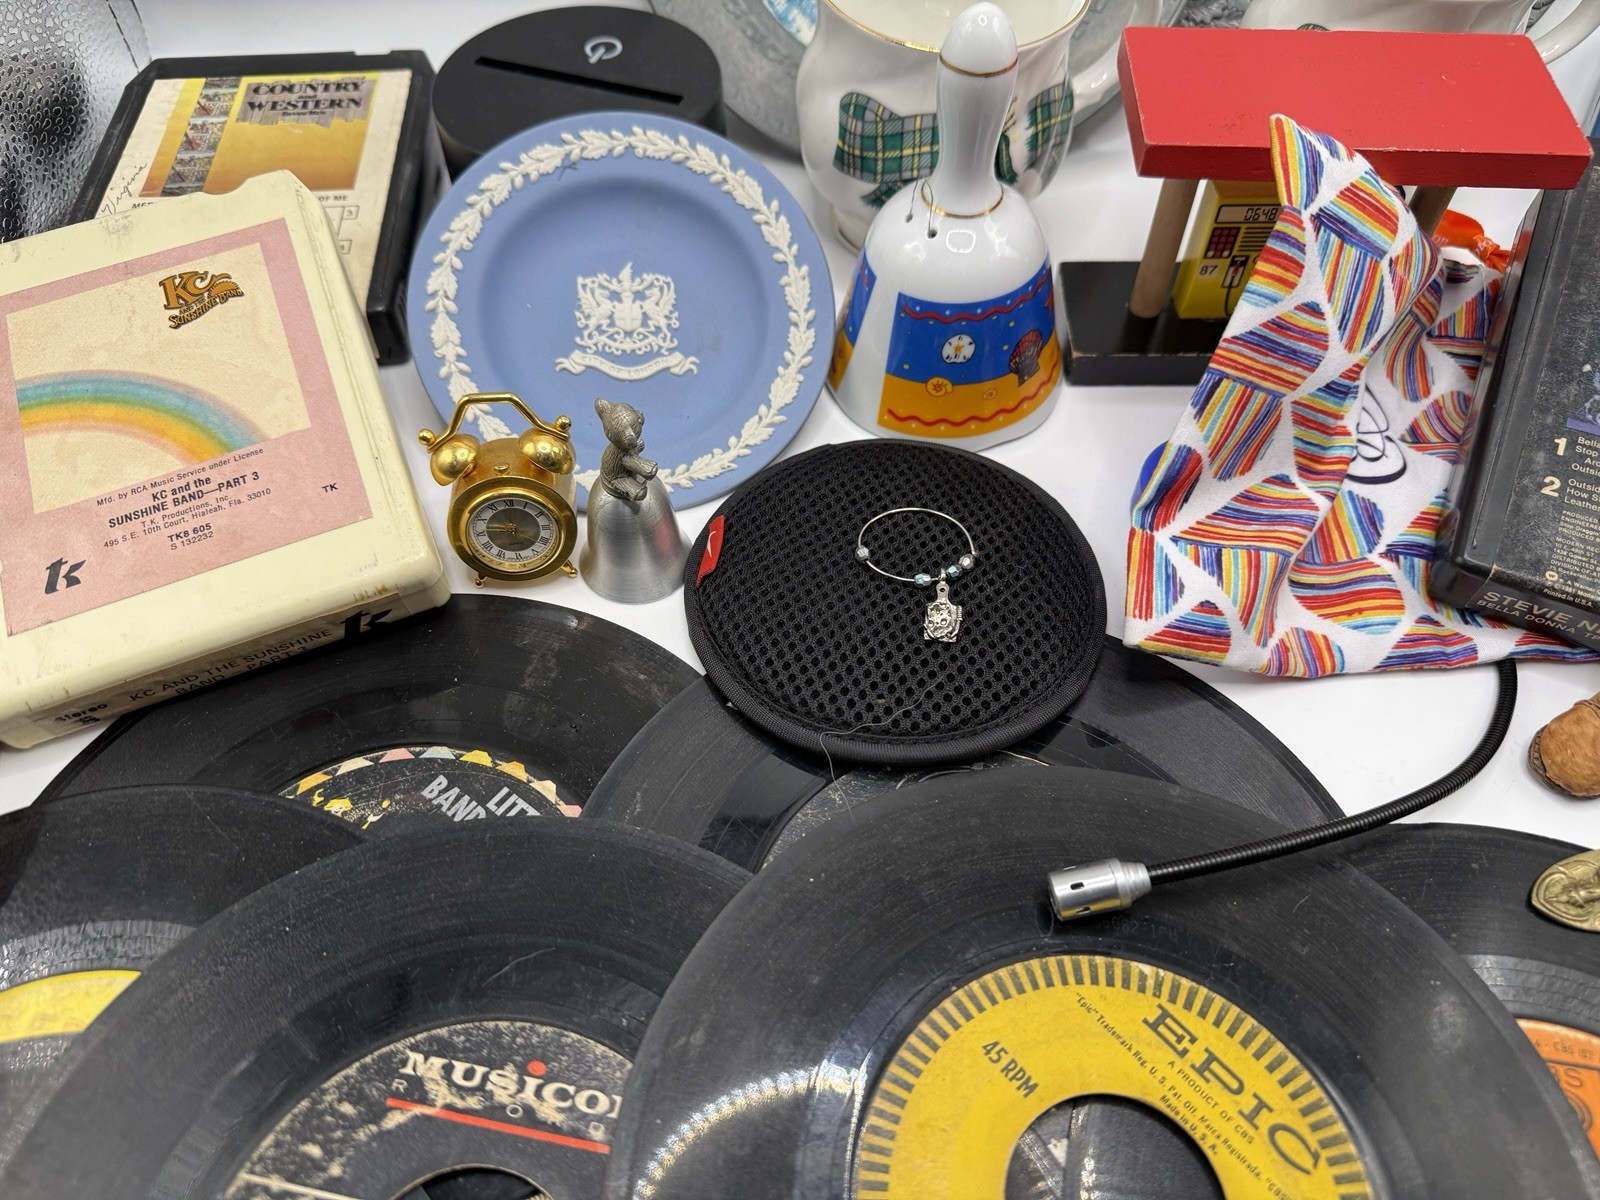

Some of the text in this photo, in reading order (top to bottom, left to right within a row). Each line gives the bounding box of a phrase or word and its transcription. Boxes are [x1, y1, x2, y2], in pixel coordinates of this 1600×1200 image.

[253, 82, 364, 96] COUNTRY
[247, 98, 363, 112] WESTERN
[1199, 265, 1218, 276] 87
[168, 296, 220, 329] SUNSHINE
[1554, 437, 1567, 456] 1
[1575, 445, 1599, 458] Stop
[96, 448, 264, 507] Mfd. by RCA Music Service under License
[152, 476, 212, 502] KC and the
[321, 482, 339, 493] TK
[1540, 475, 1561, 497] 2
[108, 500, 169, 528] SUNSHINE
[252, 471, 260, 481] 3
[1566, 487, 1589, 499] How
[103, 538, 119, 549] 495
[122, 531, 140, 542] S.E.
[143, 525, 161, 536] 10th
[163, 516, 189, 529] Court,
[228, 497, 245, 508] Fla.
[247, 487, 272, 502] 33010
[141, 517, 159, 528] T.K.
[216, 494, 232, 503] Inc.
[168, 522, 212, 543] TK8 605
[170, 530, 214, 551] S 132232
[1477, 600, 1520, 617] BELLA
[1524, 614, 1575, 634] DONNA
[1483, 591, 1573, 624] STEVIE
[129, 629, 333, 702] KC AND THE SUNSHINE
[1097, 1014, 1133, 1052] Trademark
[981, 1039, 1040, 1099] 45 RPM
[1142, 1003, 1321, 1175] EPIC
[1167, 1060, 1255, 1144] A PRODUCT OF CBS
[1160, 1094, 1180, 1116] Made
